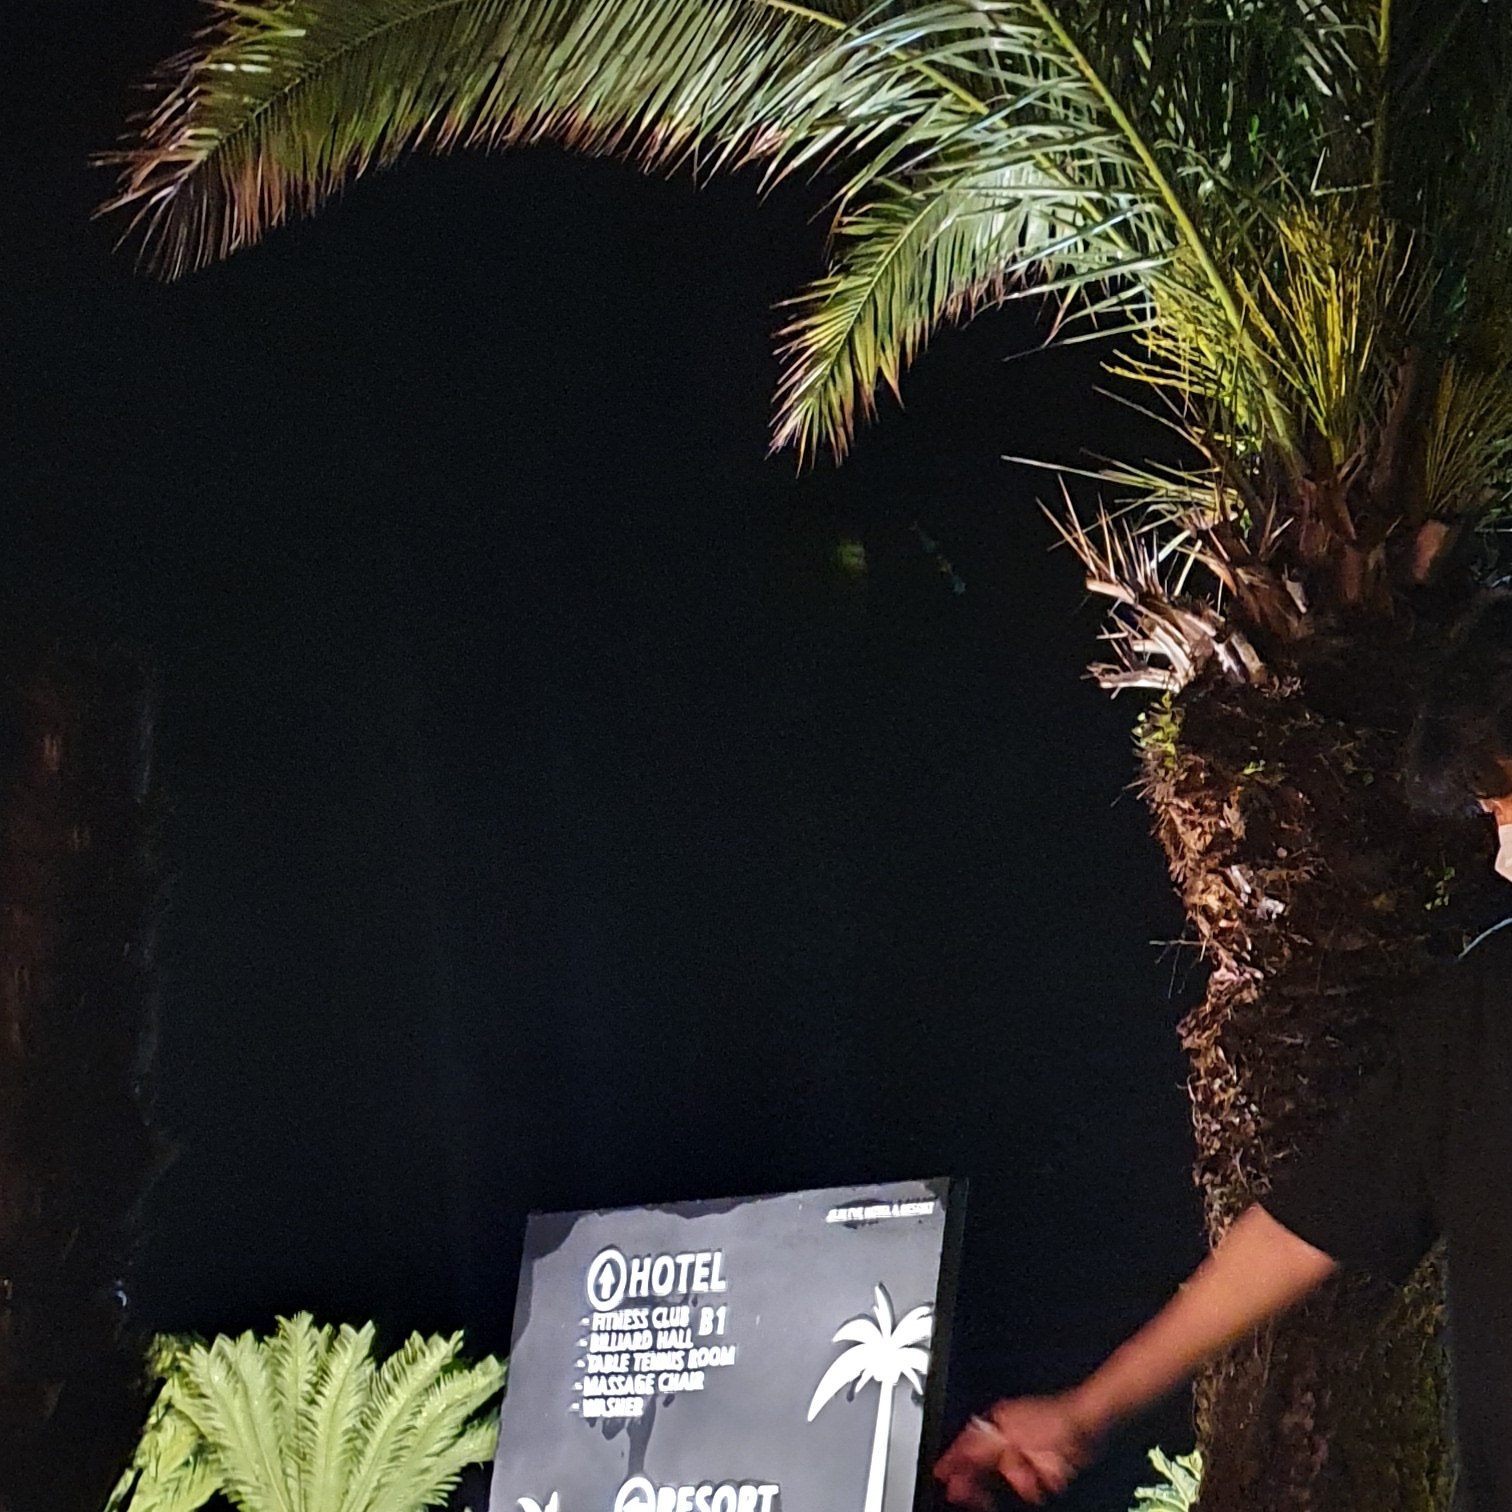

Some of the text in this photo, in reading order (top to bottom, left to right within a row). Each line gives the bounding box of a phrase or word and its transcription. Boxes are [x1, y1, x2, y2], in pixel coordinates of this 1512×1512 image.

[629, 1252, 727, 1297] HOTEL
[592, 1306, 690, 1331] FITNESS CLUB
[698, 1306, 727, 1335] B1
[590, 1328, 694, 1353] BILLIARD HALL
[586, 1346, 736, 1374] TABLE TENNIS ROOM
[583, 1371, 705, 1396] MASSAGE CHAIR
